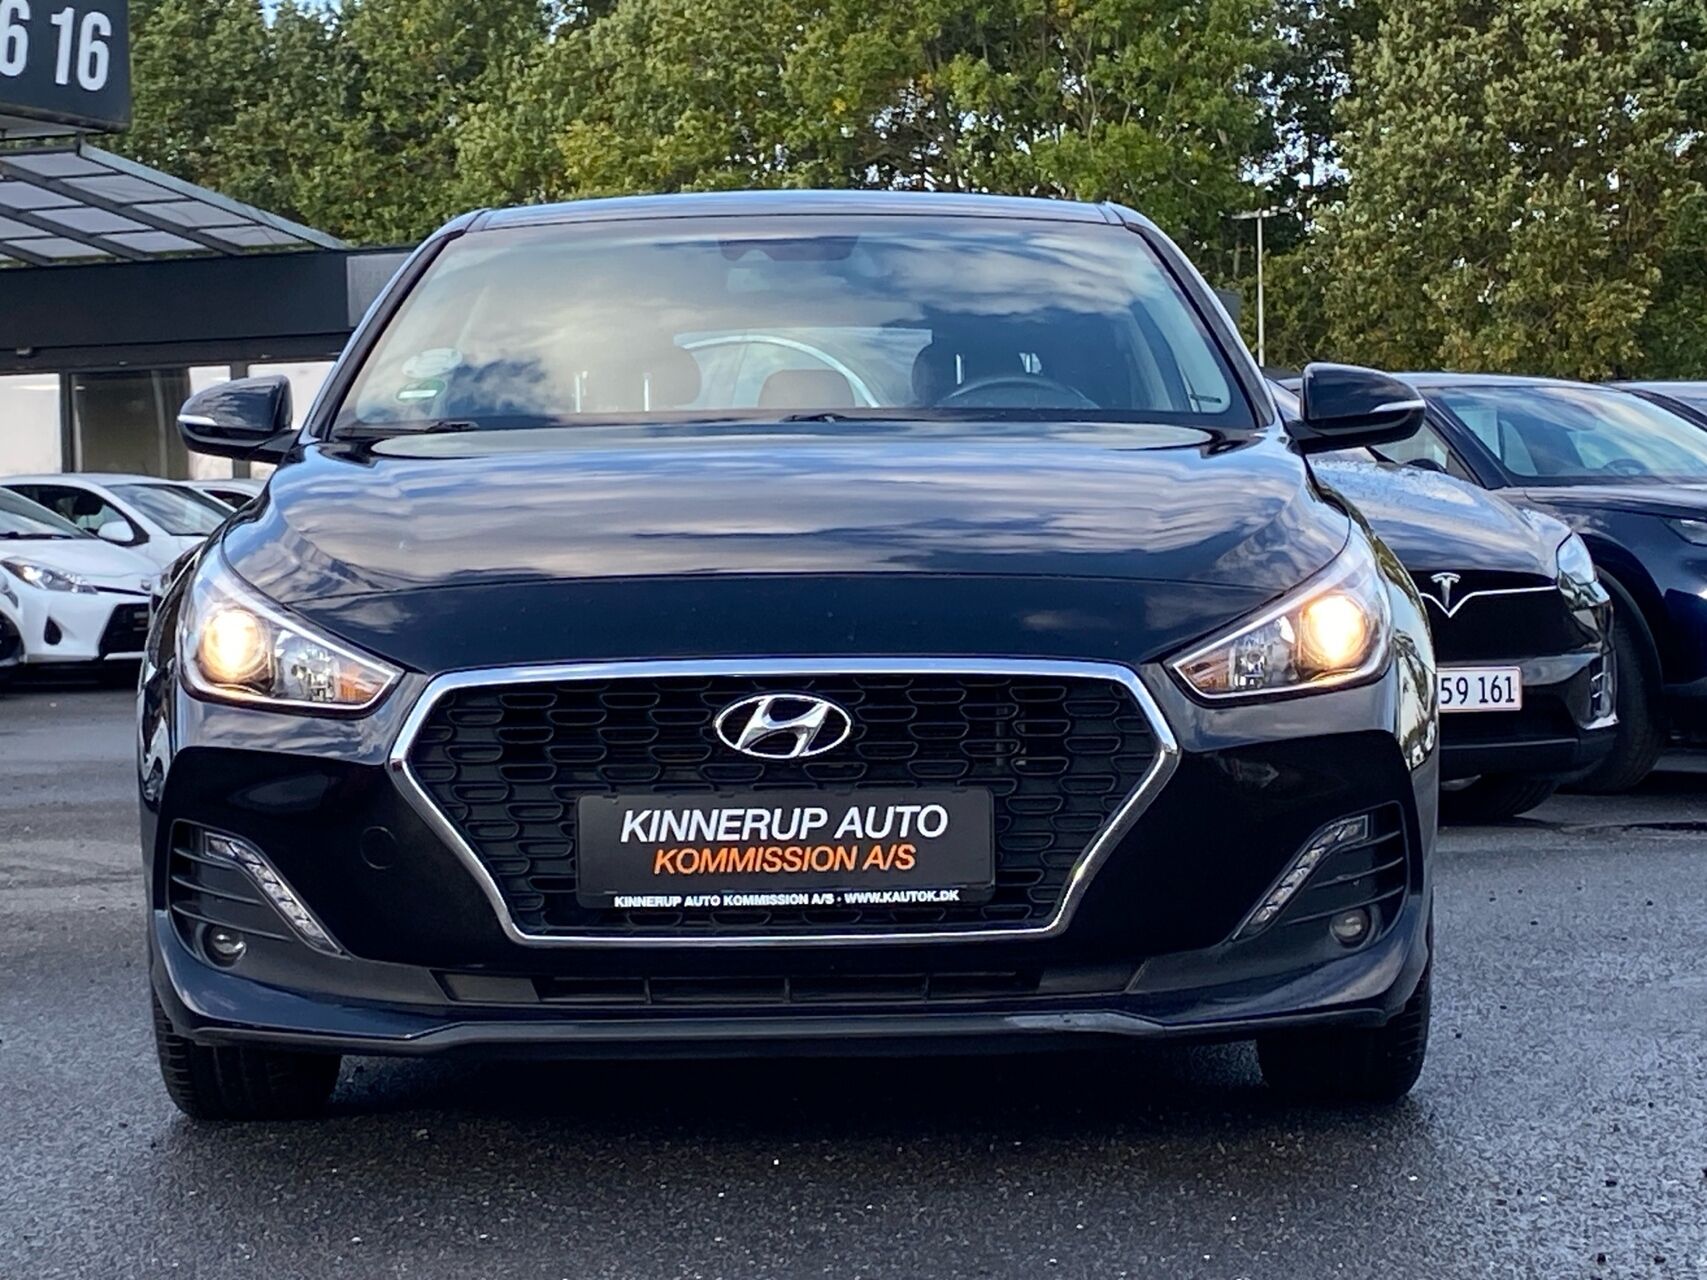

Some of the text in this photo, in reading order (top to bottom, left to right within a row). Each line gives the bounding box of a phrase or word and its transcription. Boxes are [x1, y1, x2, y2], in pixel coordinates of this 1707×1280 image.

[51, 6, 112, 91] 16
[1440, 675, 1515, 705] 59 161
[620, 804, 949, 843] KINNERUP AUTO
[653, 843, 917, 875] KOMMISSION A/S
[614, 890, 960, 908] KINNERUP AUTO KOMMISSION A/S WWW.KAUTOK.DK
